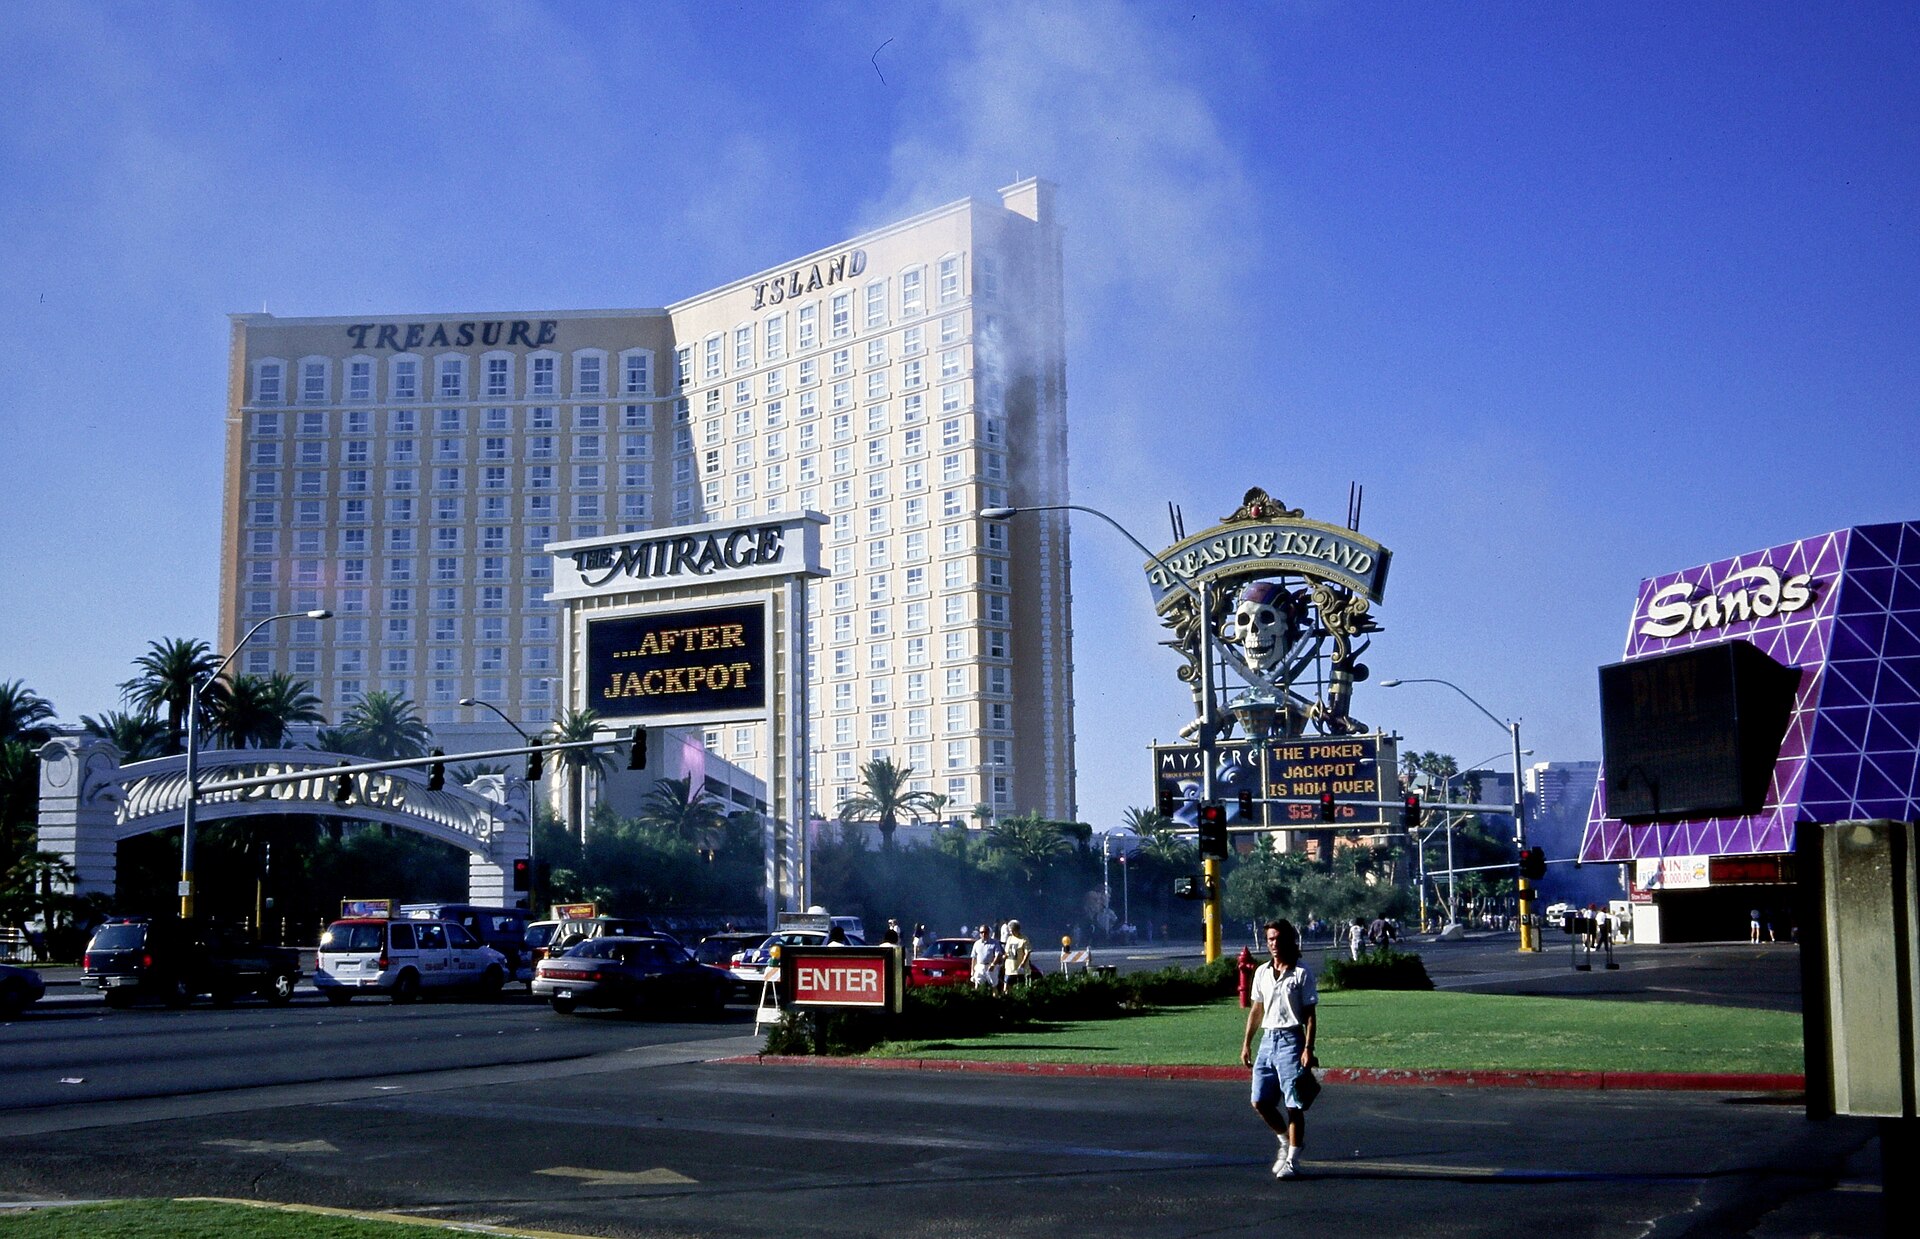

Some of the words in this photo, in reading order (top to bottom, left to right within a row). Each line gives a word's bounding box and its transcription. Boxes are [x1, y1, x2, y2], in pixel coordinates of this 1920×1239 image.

[751, 249, 867, 311] ISLAND
[347, 320, 557, 352] TREASURE
[571, 546, 615, 573] THE
[580, 526, 785, 587] MIRAGE
[1151, 531, 1274, 590] TREASURE
[1277, 531, 1372, 575] ISLAND
[1639, 565, 1813, 638] Sands
[612, 623, 746, 659] ...AFTER
[603, 662, 751, 699] JACKPOT
[1162, 747, 1257, 770] MYSÈRE
[1272, 746, 1305, 761] THE
[1310, 744, 1363, 759] POKER
[1282, 763, 1356, 779] JACKPOT
[1269, 783, 1288, 797] IS
[1293, 781, 1327, 796] NOW
[1332, 780, 1375, 794] OVER
[797, 967, 878, 993] ENTER
